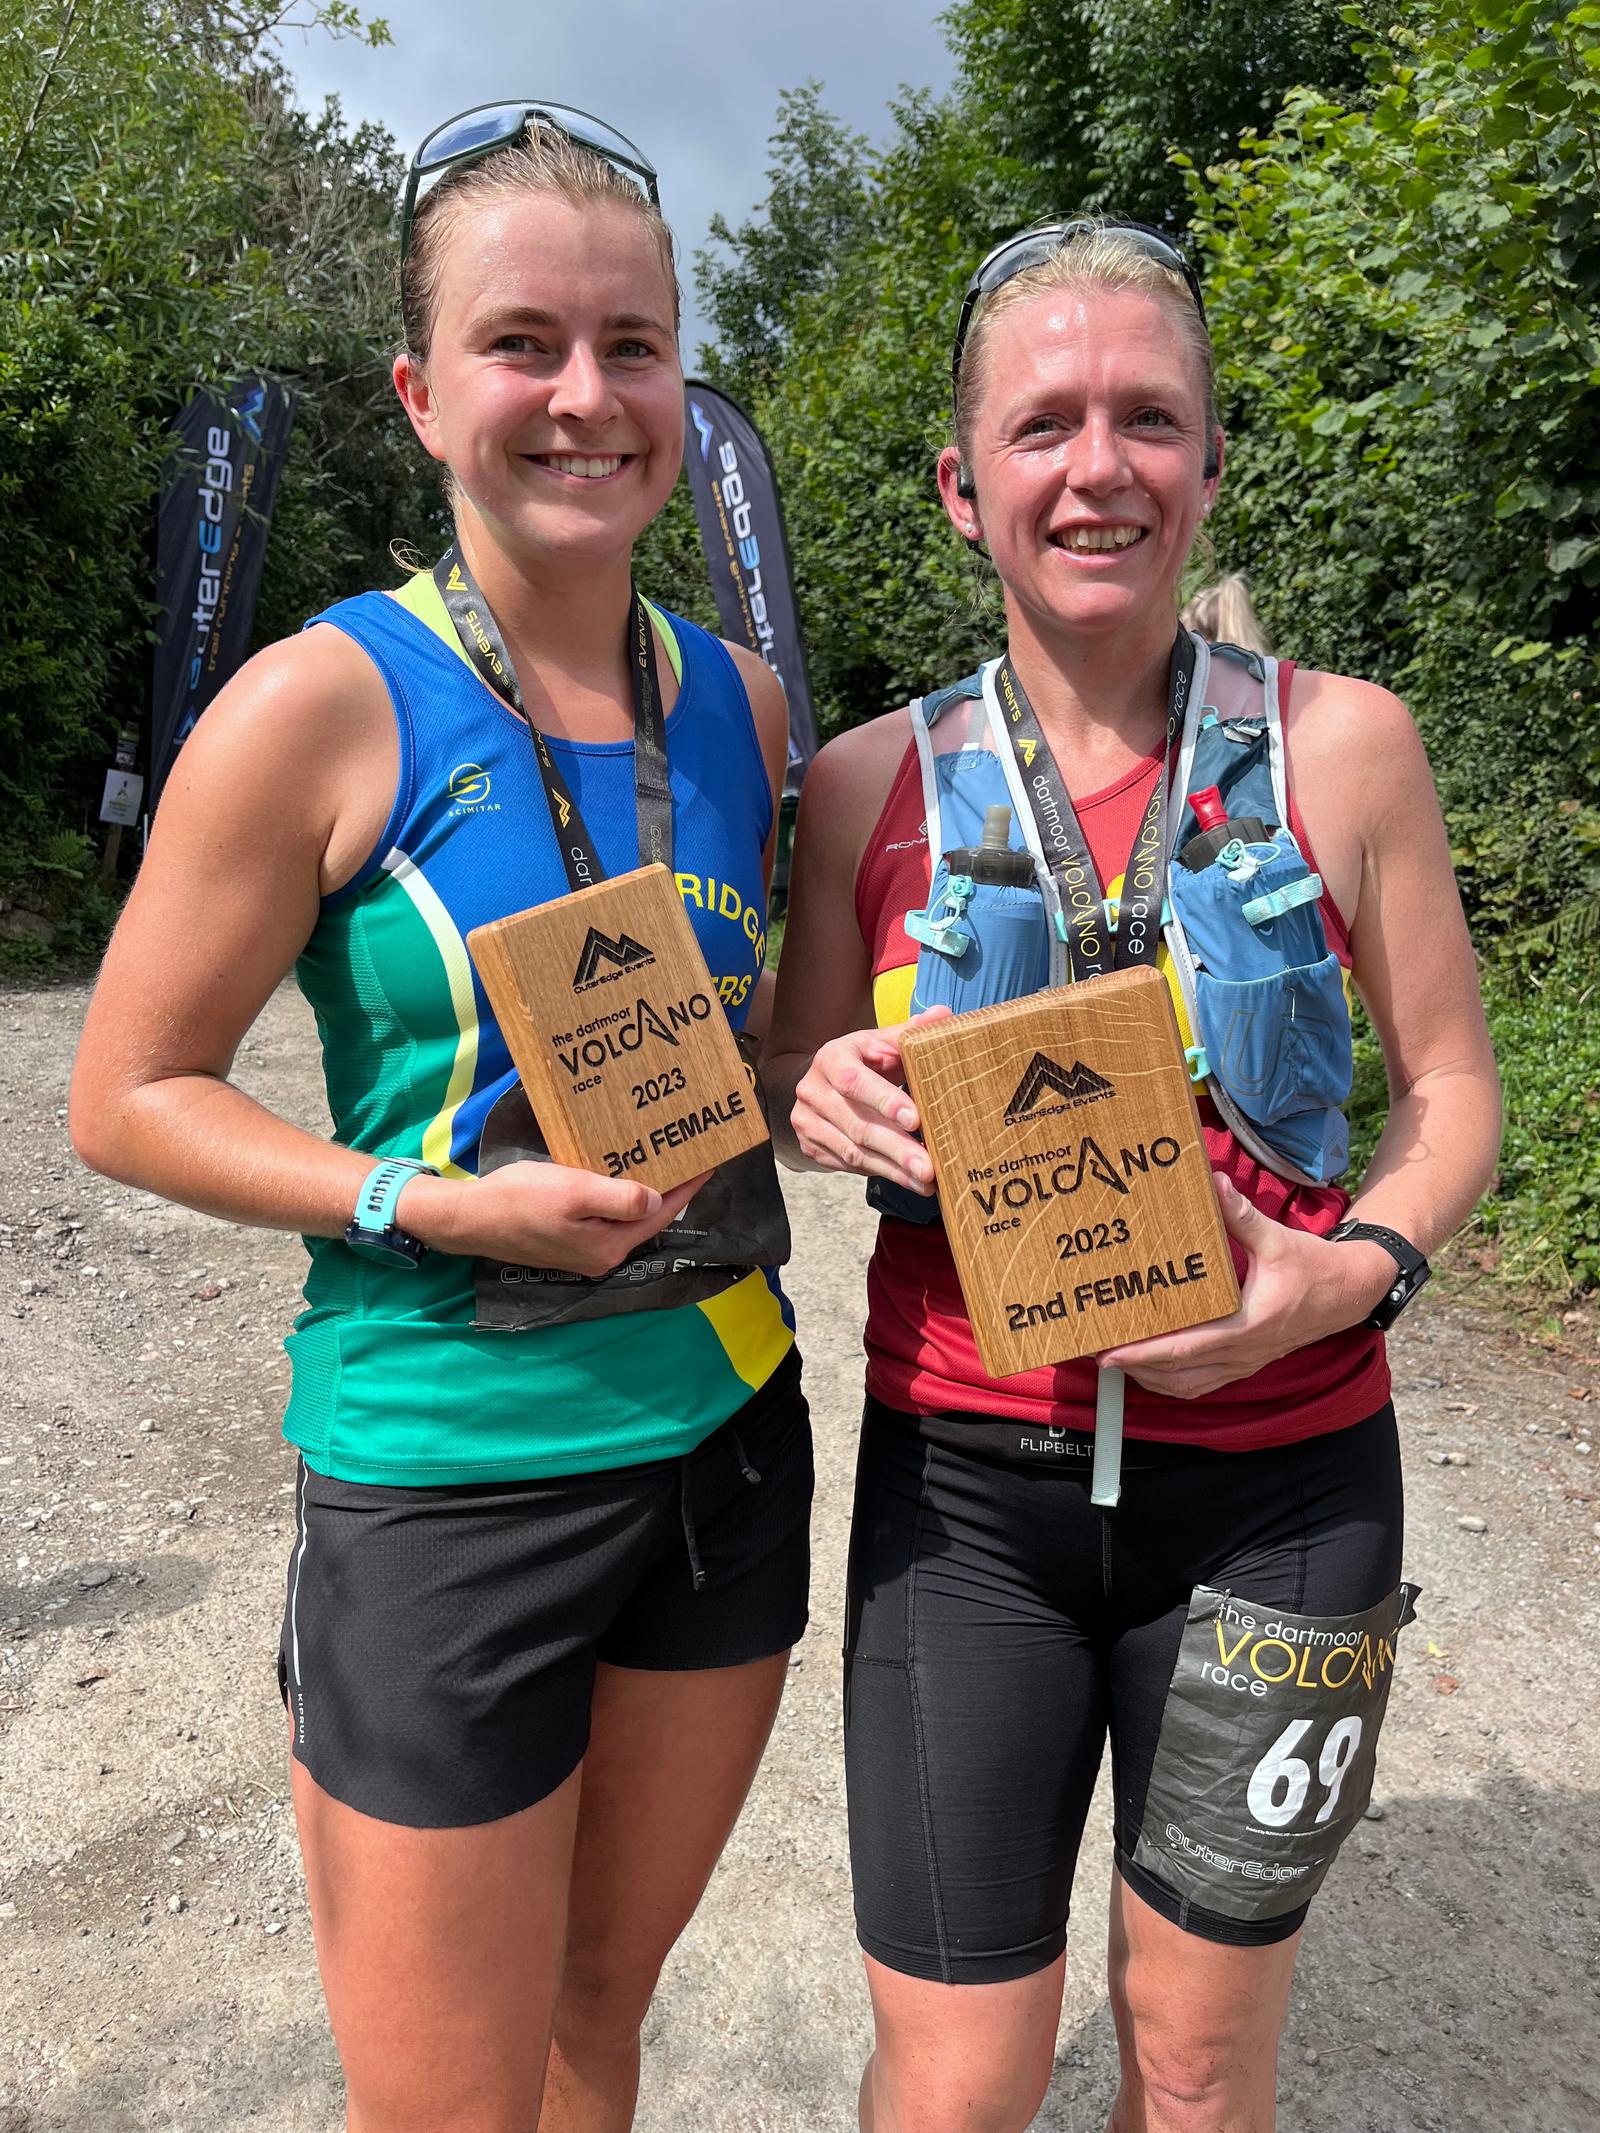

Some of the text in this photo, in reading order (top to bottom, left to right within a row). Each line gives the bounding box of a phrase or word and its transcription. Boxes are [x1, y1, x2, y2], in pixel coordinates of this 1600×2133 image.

[465, 610, 503, 675] EVENTS
[637, 603, 648, 669] EVENTS
[1000, 669, 1022, 723] EVENTS
[1174, 670, 1187, 717] race
[448, 803, 502, 817] SCIMITAR
[1032, 774, 1071, 853] dartmoor
[1060, 852, 1100, 957] VOLCANO
[1128, 784, 1163, 955] VOLCANO race
[674, 872, 767, 968] RIDGE
[573, 955, 657, 995] OuterEdge Events
[552, 1005, 631, 1048] the dartmoor
[558, 993, 711, 1078] VOLCANO
[572, 1073, 603, 1096] race
[631, 1067, 687, 1110] 2023
[1004, 1088, 1116, 1127] OuterEdge Events
[603, 1091, 746, 1178] 3rd FEMALE
[967, 1144, 1072, 1184] the dartmoor
[971, 1136, 1181, 1216] VOLCANO
[984, 1216, 1021, 1237] race
[1056, 1218, 1131, 1260] 2023
[1006, 1252, 1207, 1332] 2nd FEMALE
[1020, 1437, 1094, 1457] FLIPBELT
[1218, 1603, 1364, 1648] the dartmoor
[1201, 1660, 1268, 1697] race
[1215, 1619, 1398, 1690] VOLCAN
[297, 1693, 305, 1744] KIPRUN
[1246, 1715, 1363, 1827] 69
